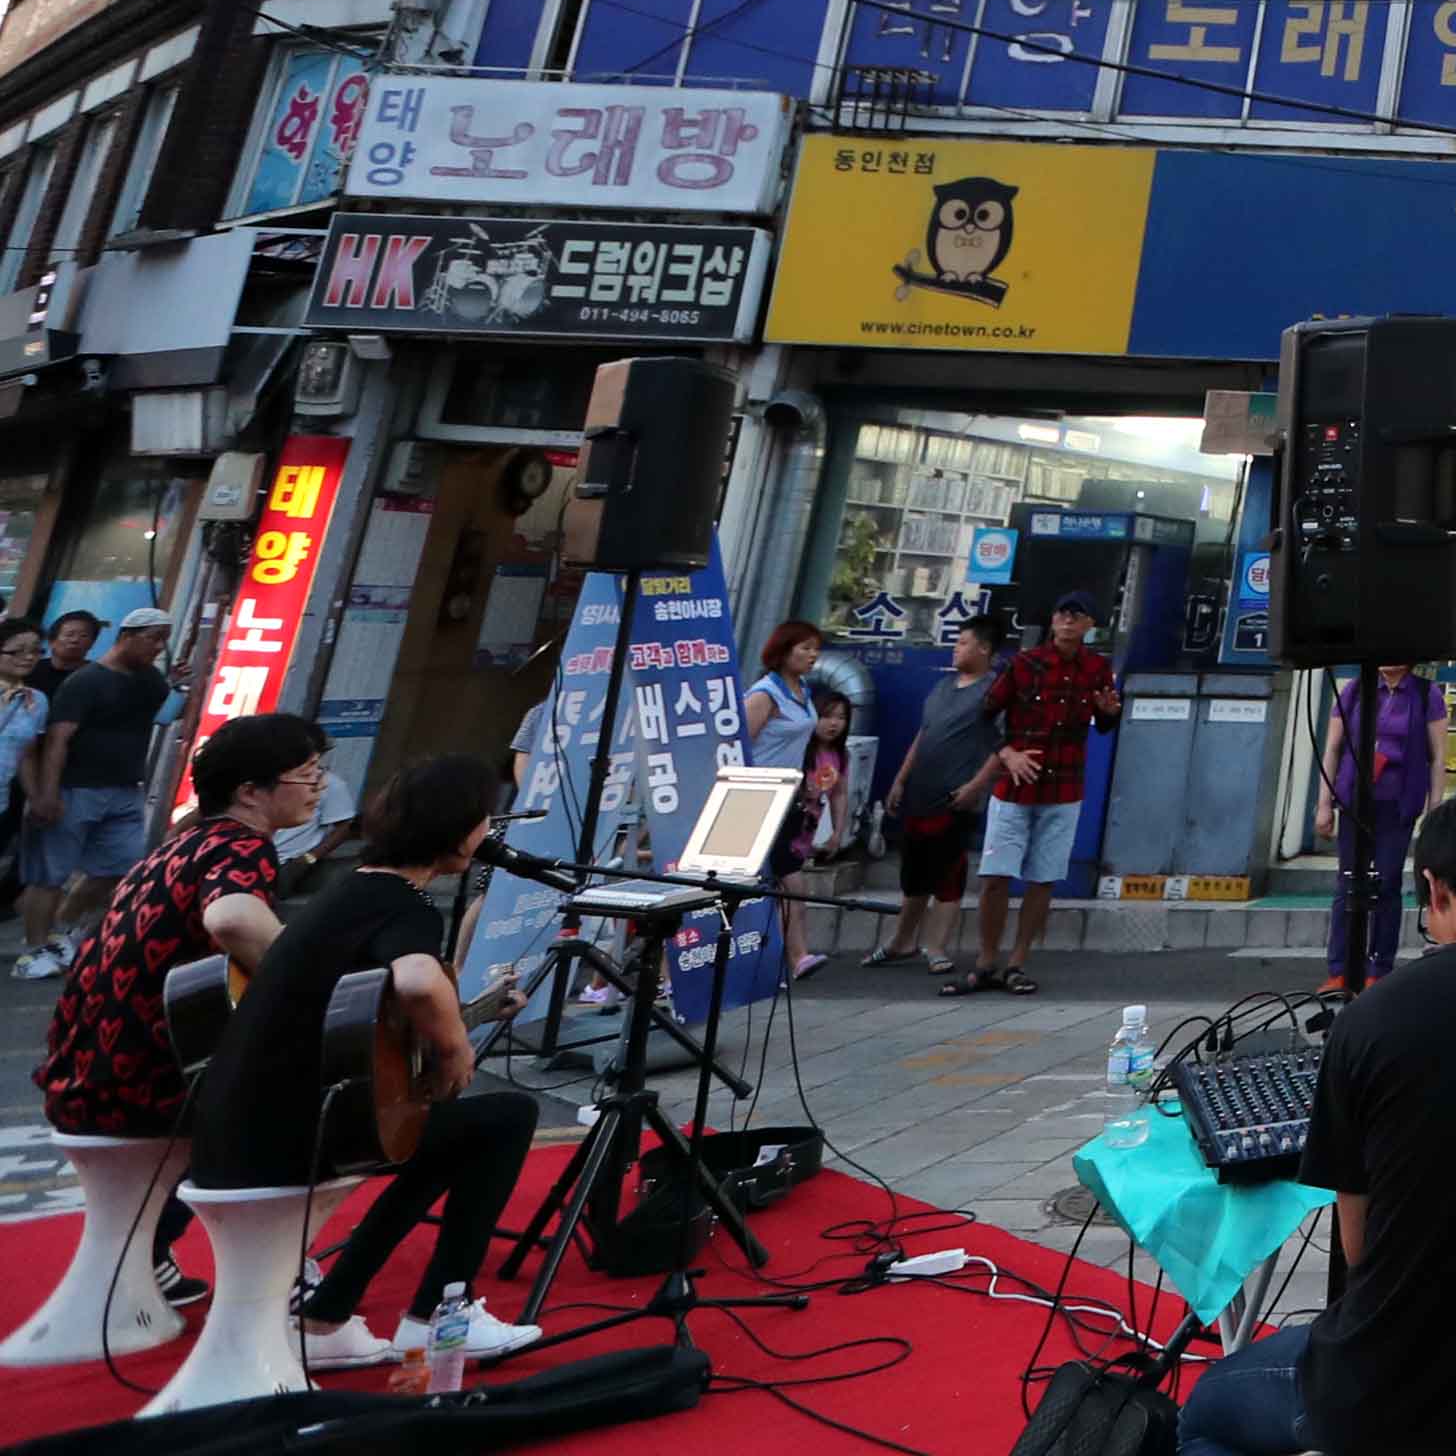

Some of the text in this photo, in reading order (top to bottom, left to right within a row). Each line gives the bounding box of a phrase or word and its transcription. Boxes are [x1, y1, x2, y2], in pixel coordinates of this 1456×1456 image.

[366, 87, 427, 187] 태양
[429, 104, 760, 191] 노래방
[834, 149, 936, 176] 동인천점
[322, 233, 433, 311] HK
[549, 238, 745, 307] 드럼워크샵
[579, 307, 701, 326] 011-494-8065
[860, 320, 1037, 340] www.cinetown.co.kr
[252, 465, 327, 585] 태양
[636, 676, 741, 745] 버스킹
